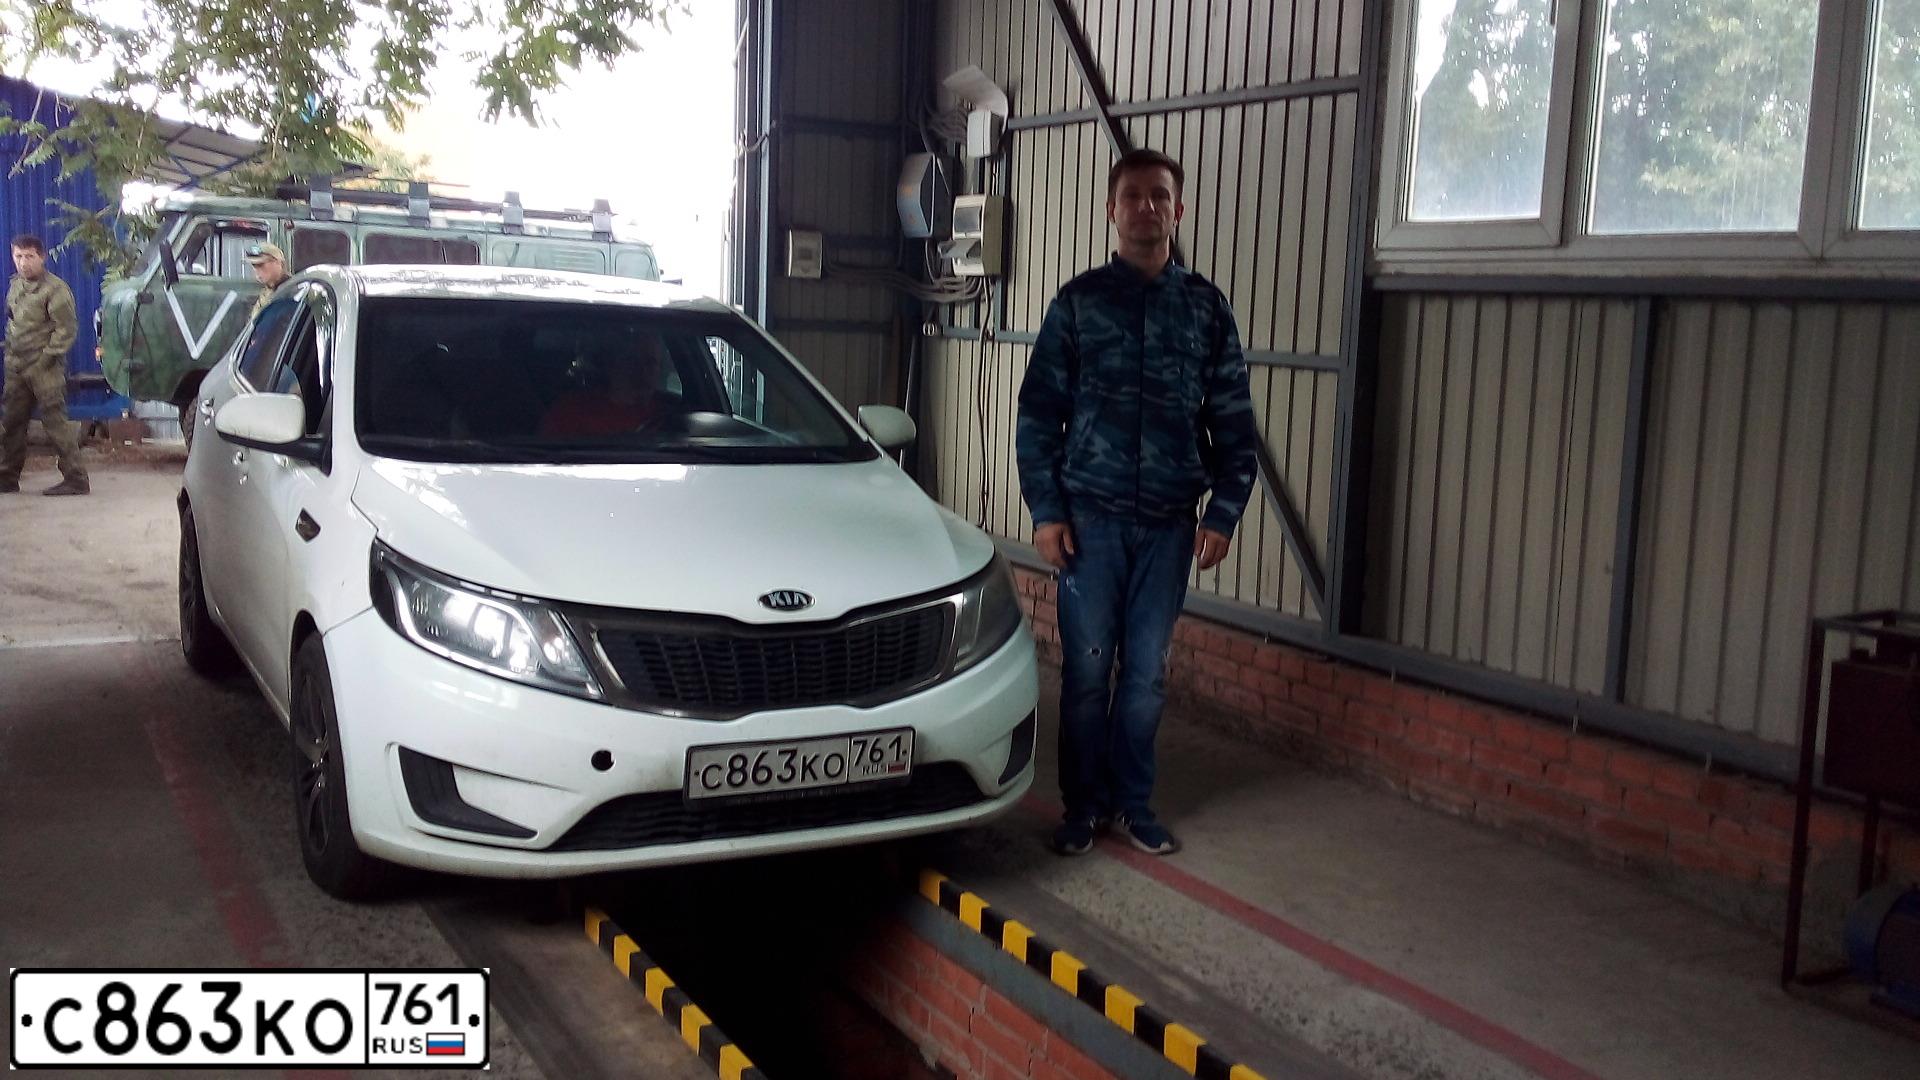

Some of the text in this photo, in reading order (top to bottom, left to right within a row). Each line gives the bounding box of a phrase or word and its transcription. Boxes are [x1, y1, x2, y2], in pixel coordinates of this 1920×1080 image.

[768, 591, 808, 607] KIA
[852, 735, 902, 767] 761
[701, 747, 845, 790] C863KO
[862, 763, 887, 776] RUS
